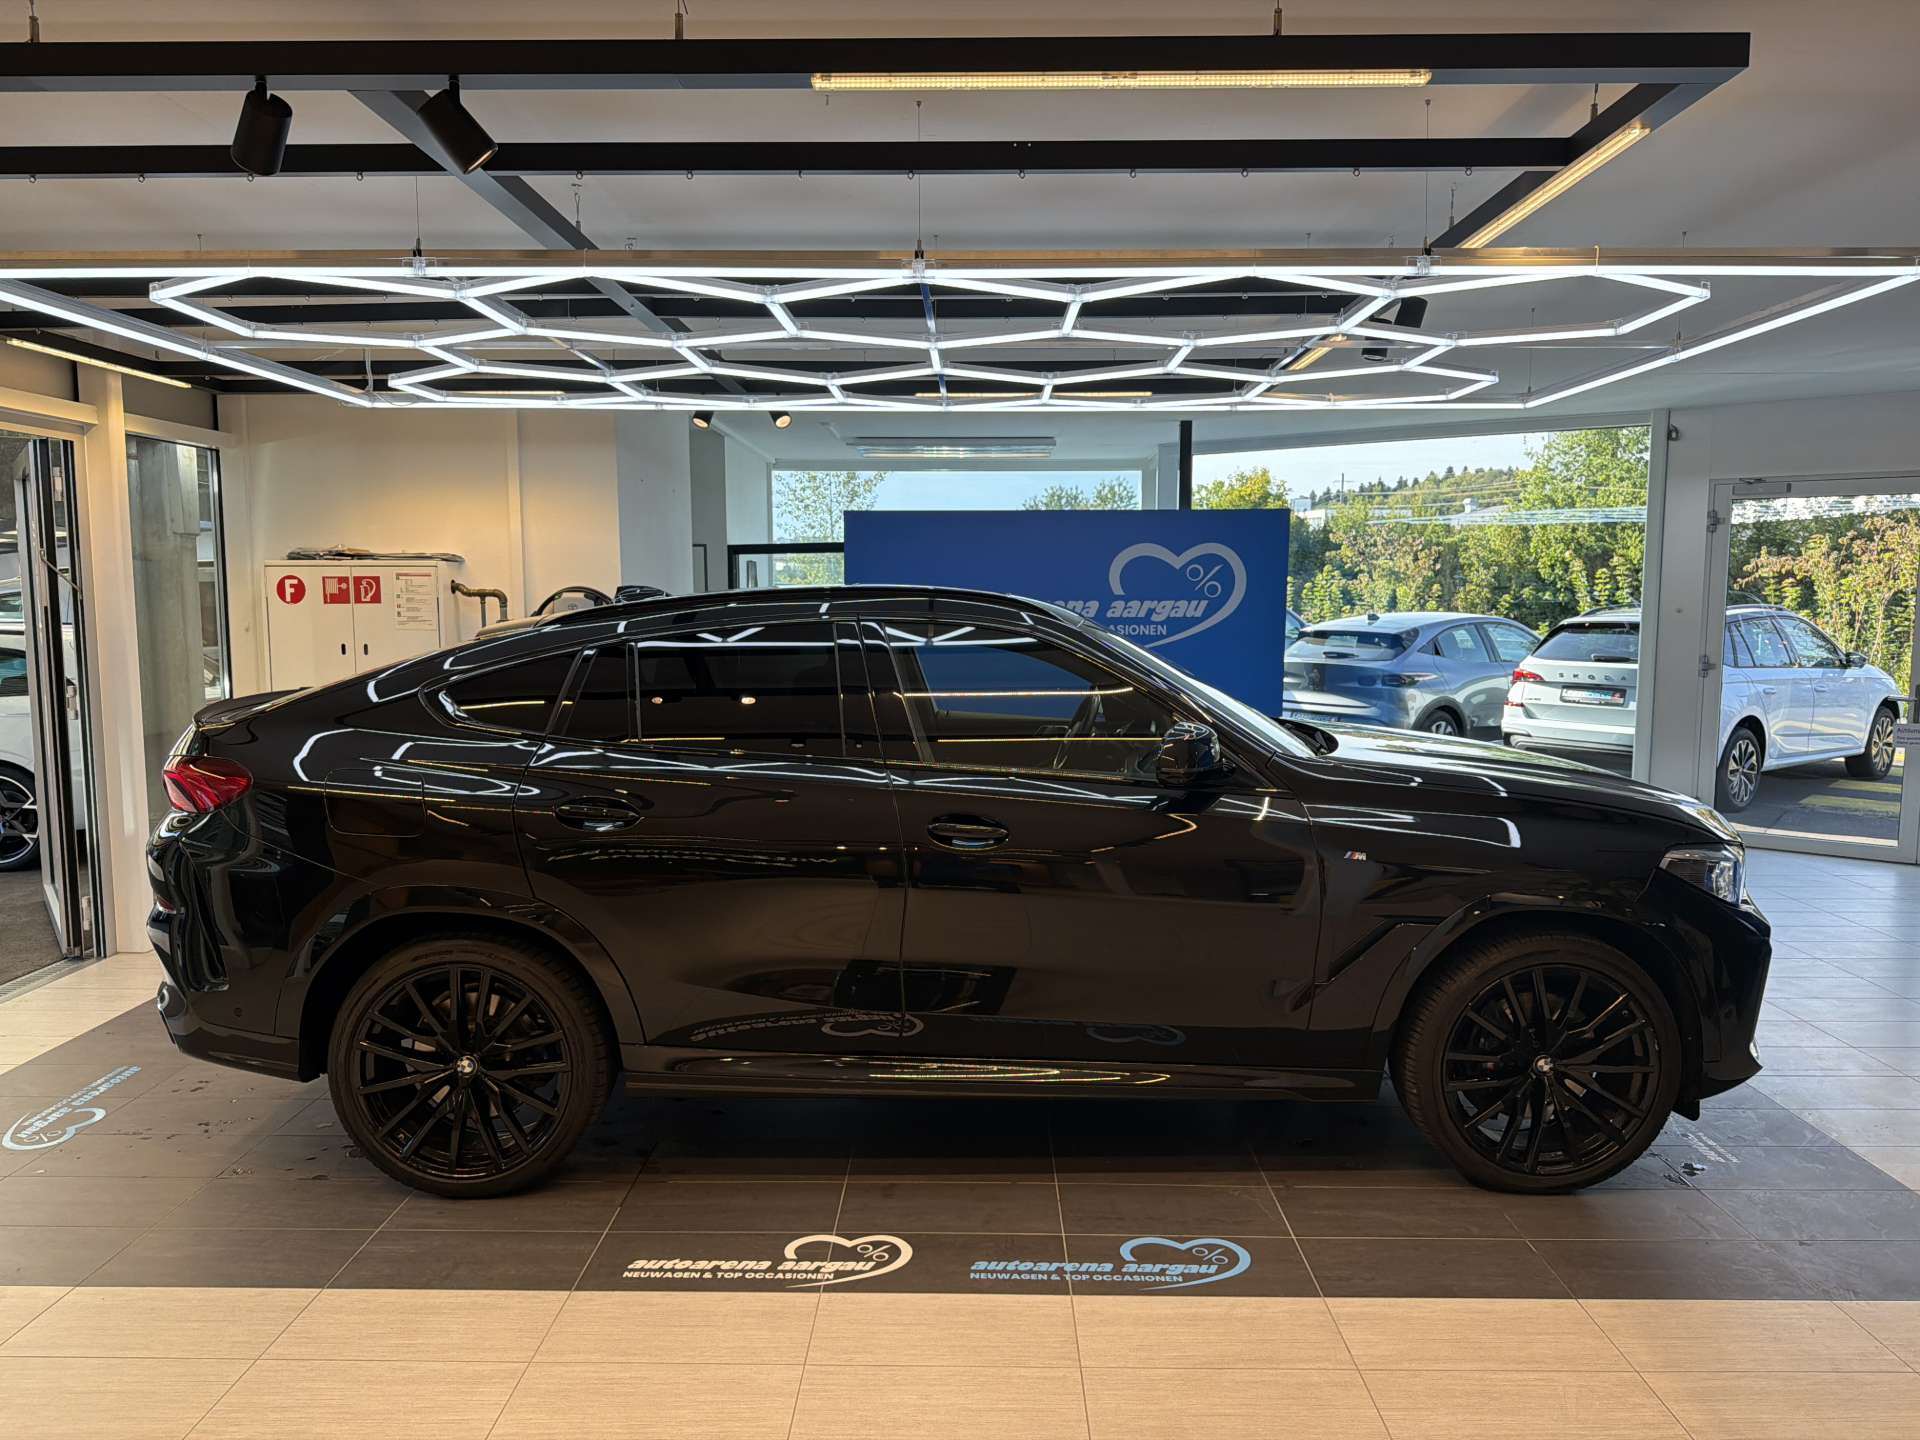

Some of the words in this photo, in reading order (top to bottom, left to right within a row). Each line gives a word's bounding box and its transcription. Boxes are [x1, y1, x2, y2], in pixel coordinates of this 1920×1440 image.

[284, 578, 298, 603] F
[1106, 600, 1208, 622] aargau
[626, 1258, 773, 1271] autoarena
[777, 1261, 877, 1273] aargau
[970, 1260, 1114, 1273] autoarena
[1121, 1263, 1219, 1275] aargau
[622, 1271, 701, 1279] NEUWAGEN
[744, 1272, 834, 1280] OCCASIONEN
[970, 1272, 1048, 1281] NEUWAGEN
[1050, 1273, 1061, 1281] &
[1063, 1273, 1090, 1281] TOP
[1092, 1274, 1183, 1282] OCCASIONEN
